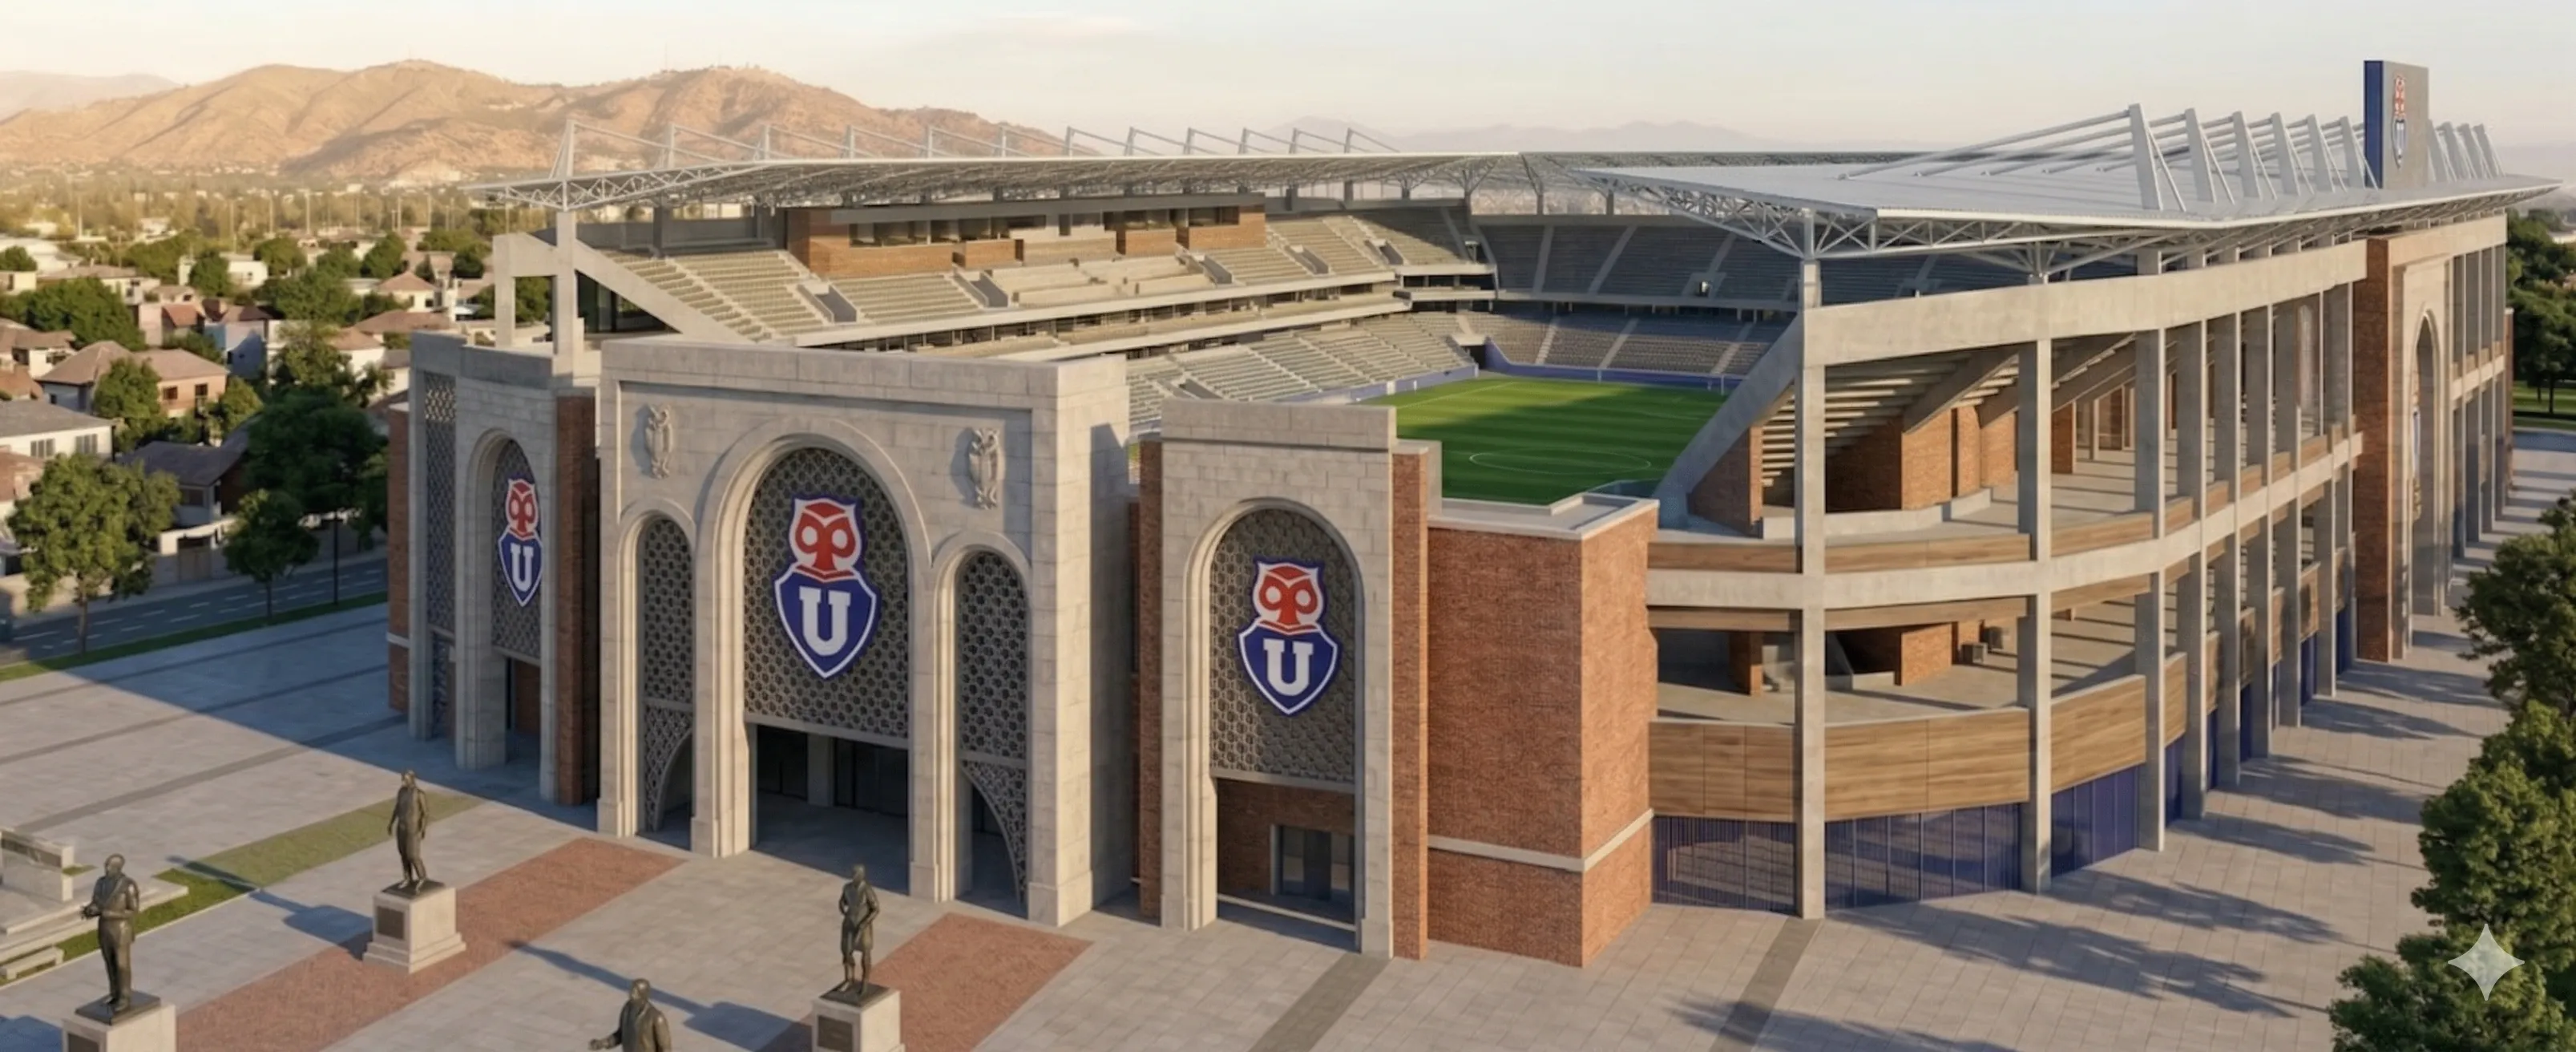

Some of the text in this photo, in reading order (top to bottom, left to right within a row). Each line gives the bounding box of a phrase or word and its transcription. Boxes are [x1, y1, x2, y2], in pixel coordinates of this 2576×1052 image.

[511, 543, 534, 592] U
[799, 586, 851, 656] U
[1263, 638, 1314, 696] U
